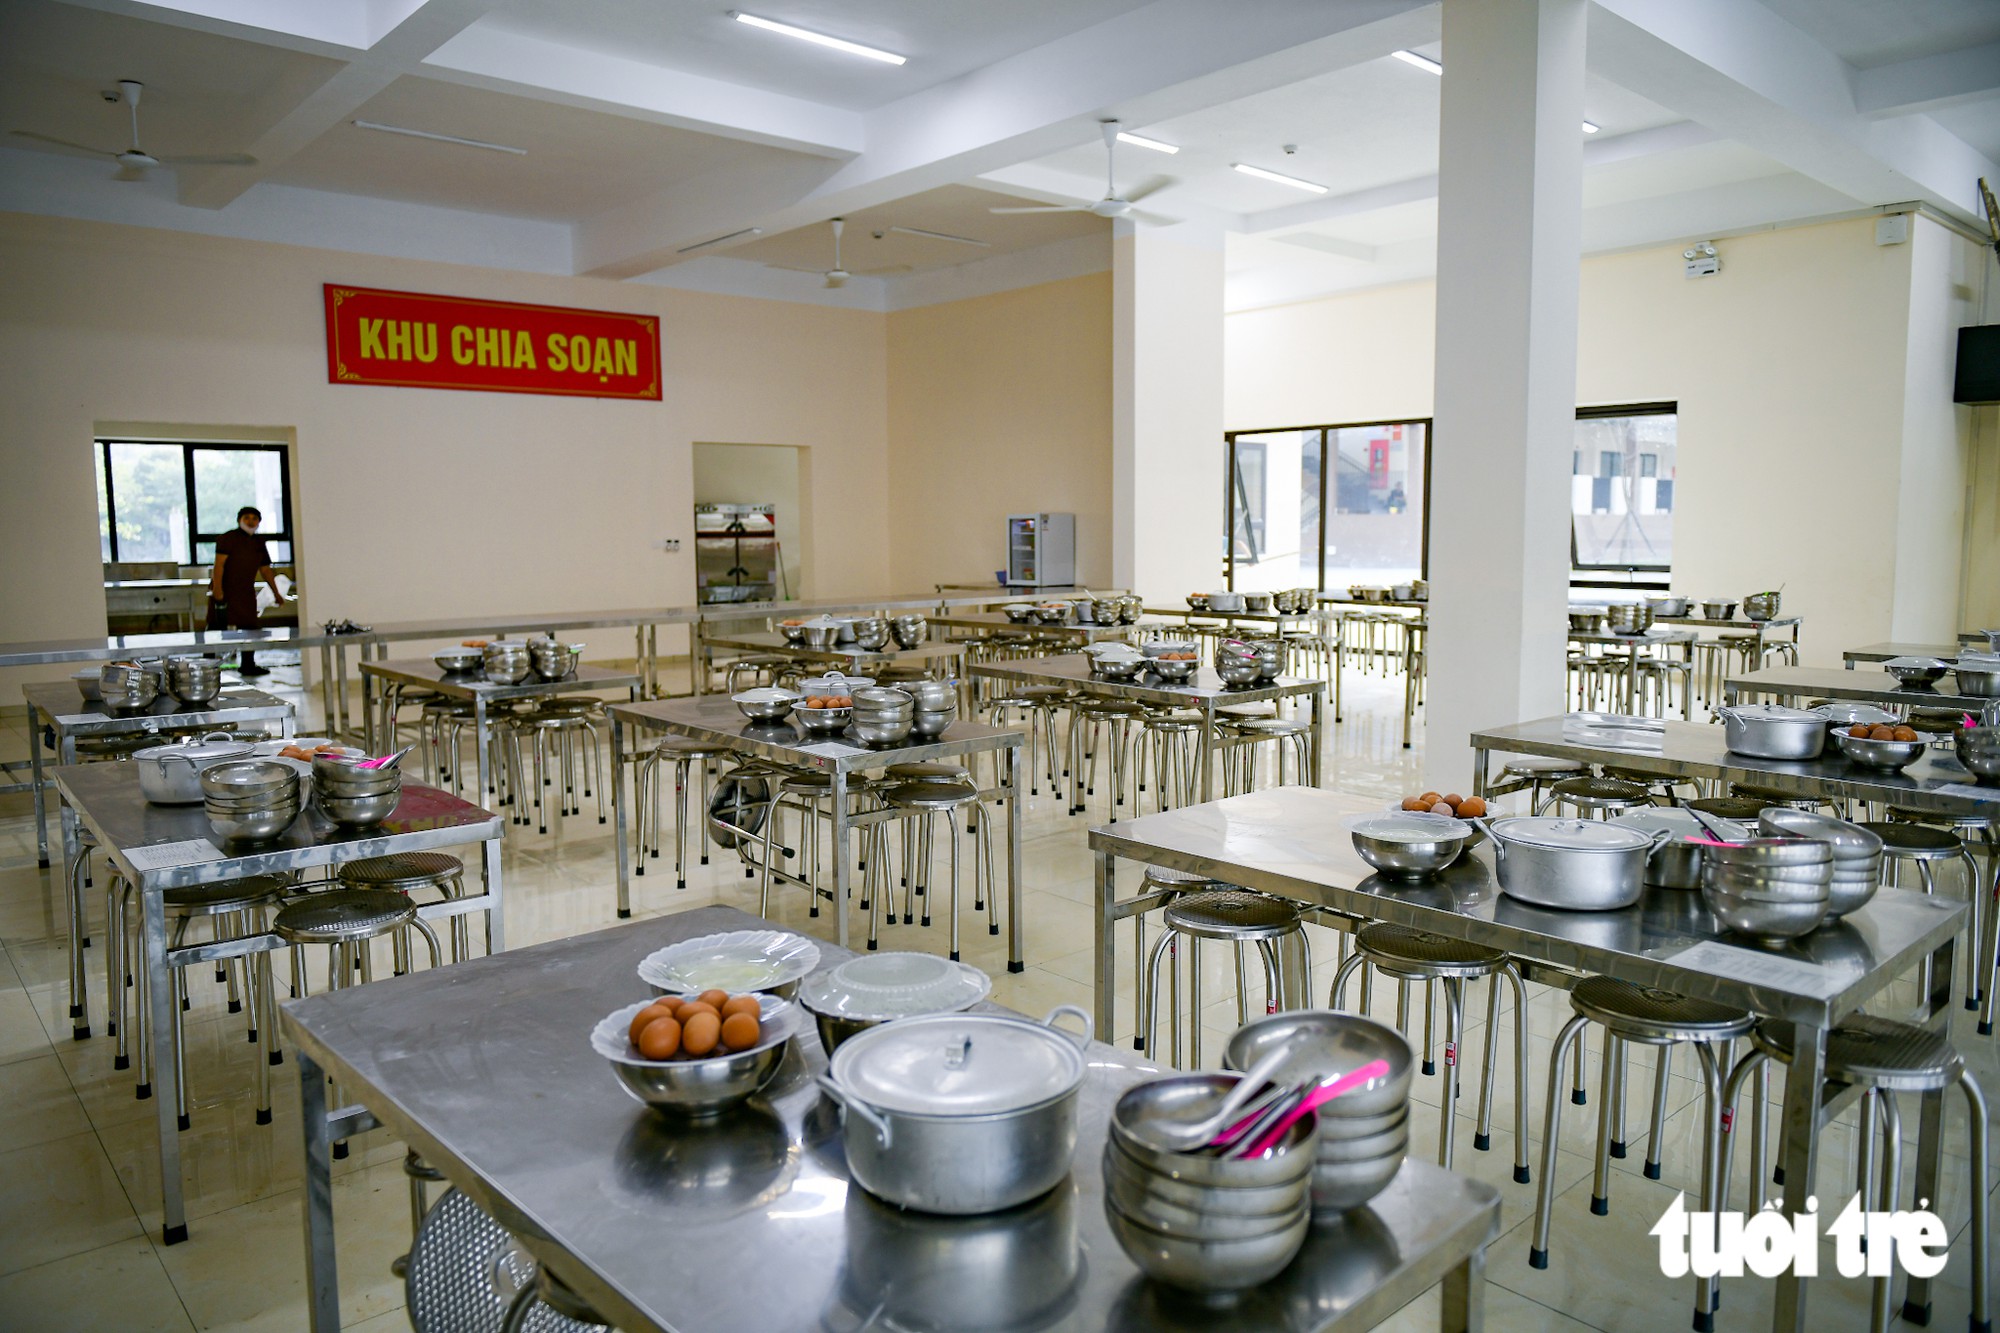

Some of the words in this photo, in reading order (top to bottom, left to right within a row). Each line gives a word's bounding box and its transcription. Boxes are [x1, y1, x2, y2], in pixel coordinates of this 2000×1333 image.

[359, 316, 439, 364] KHU
[451, 324, 537, 370] CHIA
[547, 333, 638, 383] SOẠN
